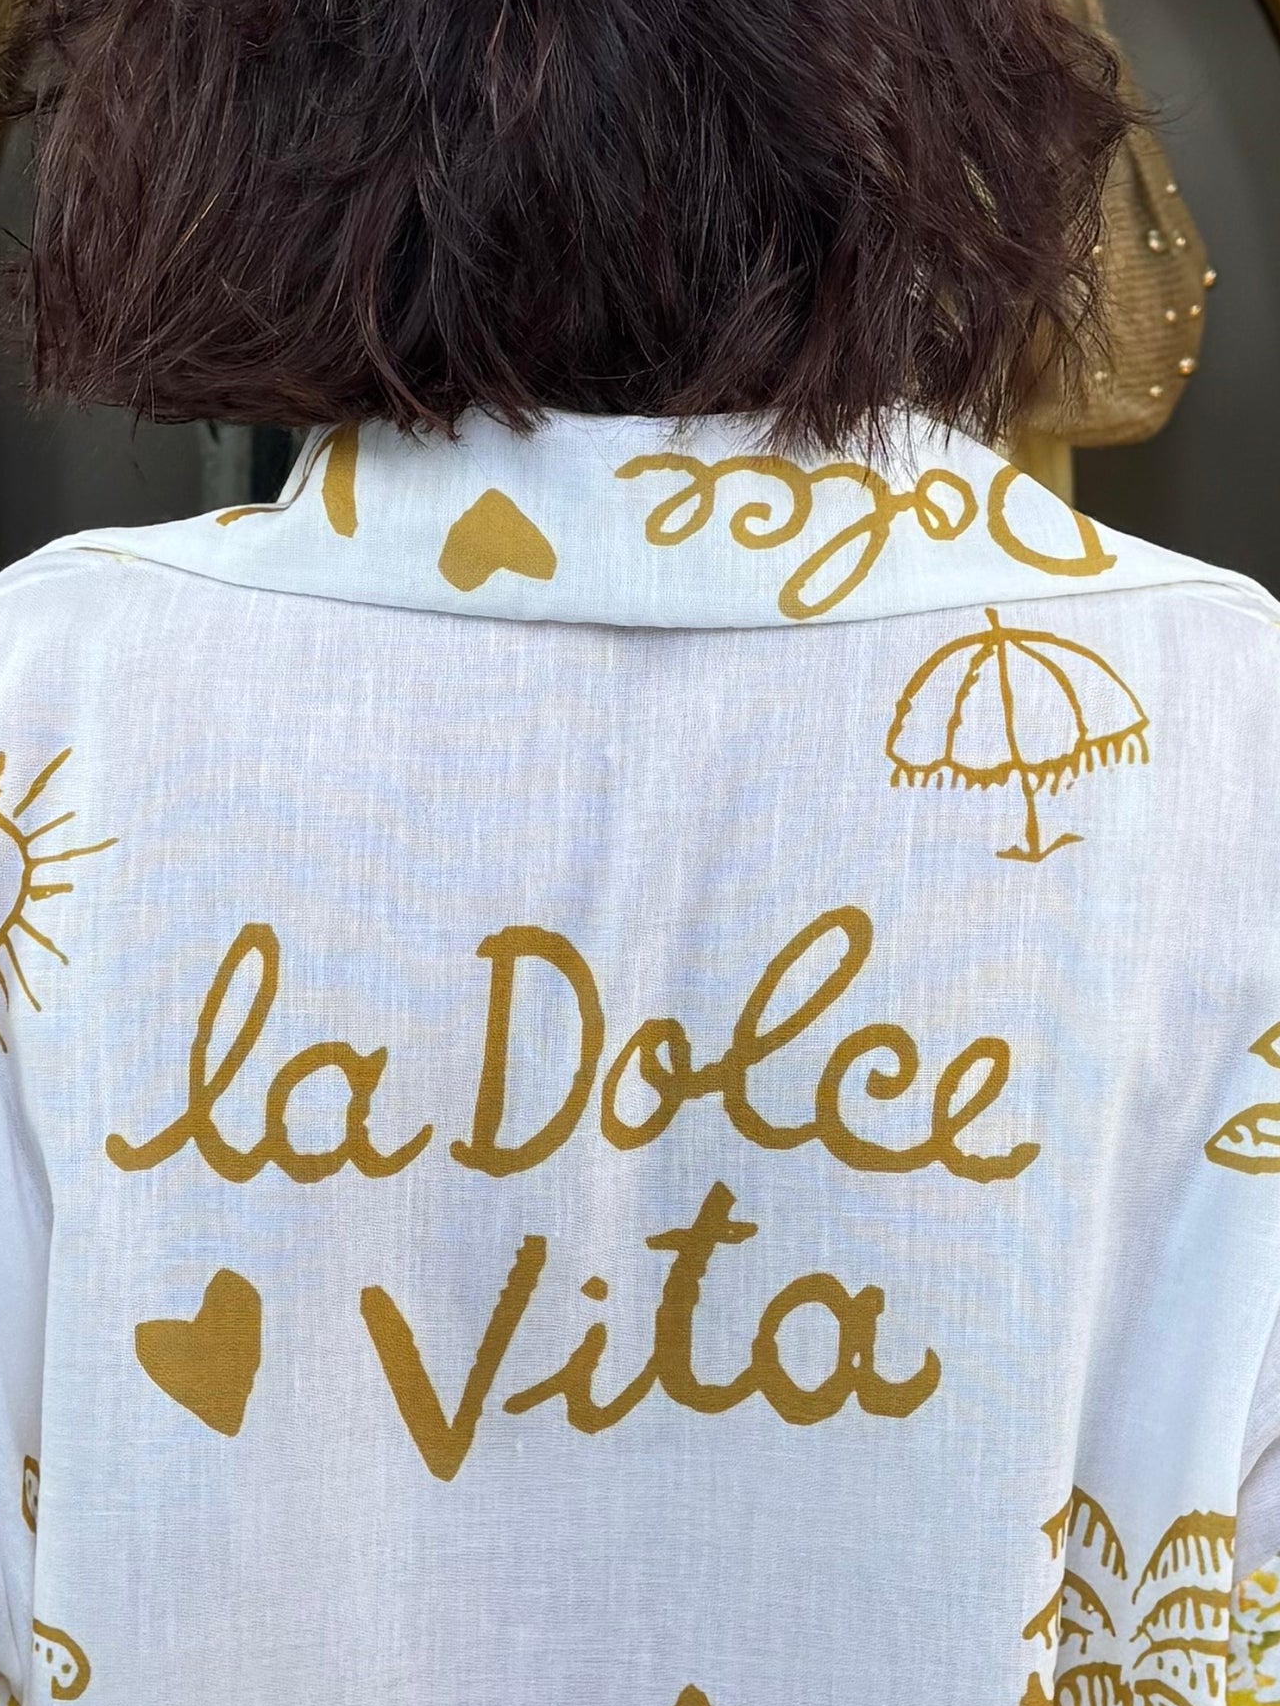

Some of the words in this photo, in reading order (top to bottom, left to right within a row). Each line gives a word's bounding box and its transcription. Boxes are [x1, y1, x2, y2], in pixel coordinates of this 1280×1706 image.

[614, 451, 1117, 621] Dolce
[106, 922, 432, 1182] la
[449, 905, 1040, 1183] Dolce
[359, 1181, 939, 1481] Vita
